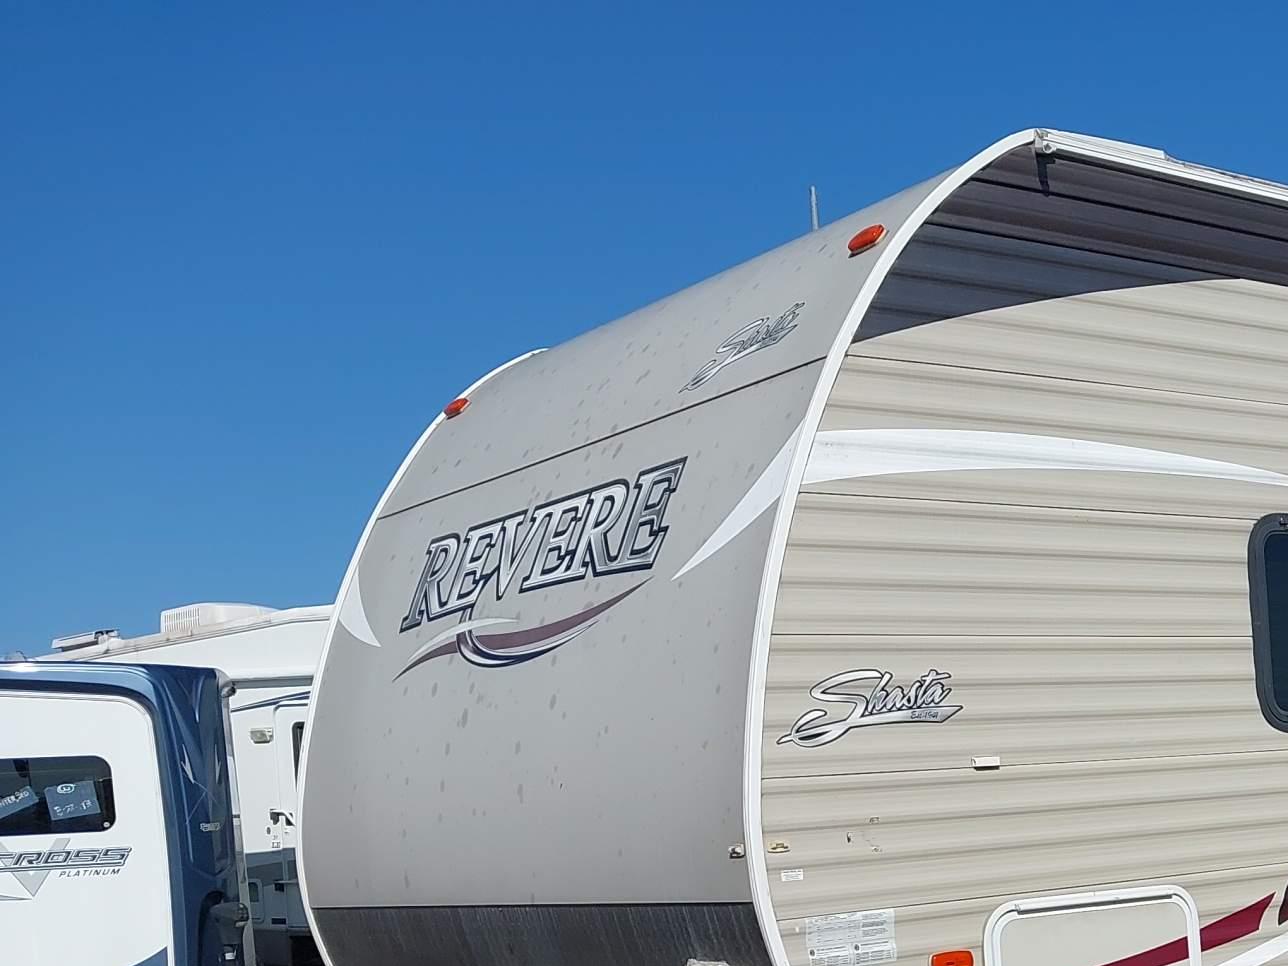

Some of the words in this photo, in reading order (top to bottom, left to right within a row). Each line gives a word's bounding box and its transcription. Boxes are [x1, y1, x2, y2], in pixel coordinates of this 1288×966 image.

[399, 456, 688, 634] REVERE
[776, 669, 953, 748] Shasta
[59, 868, 121, 878] PLATINUM
